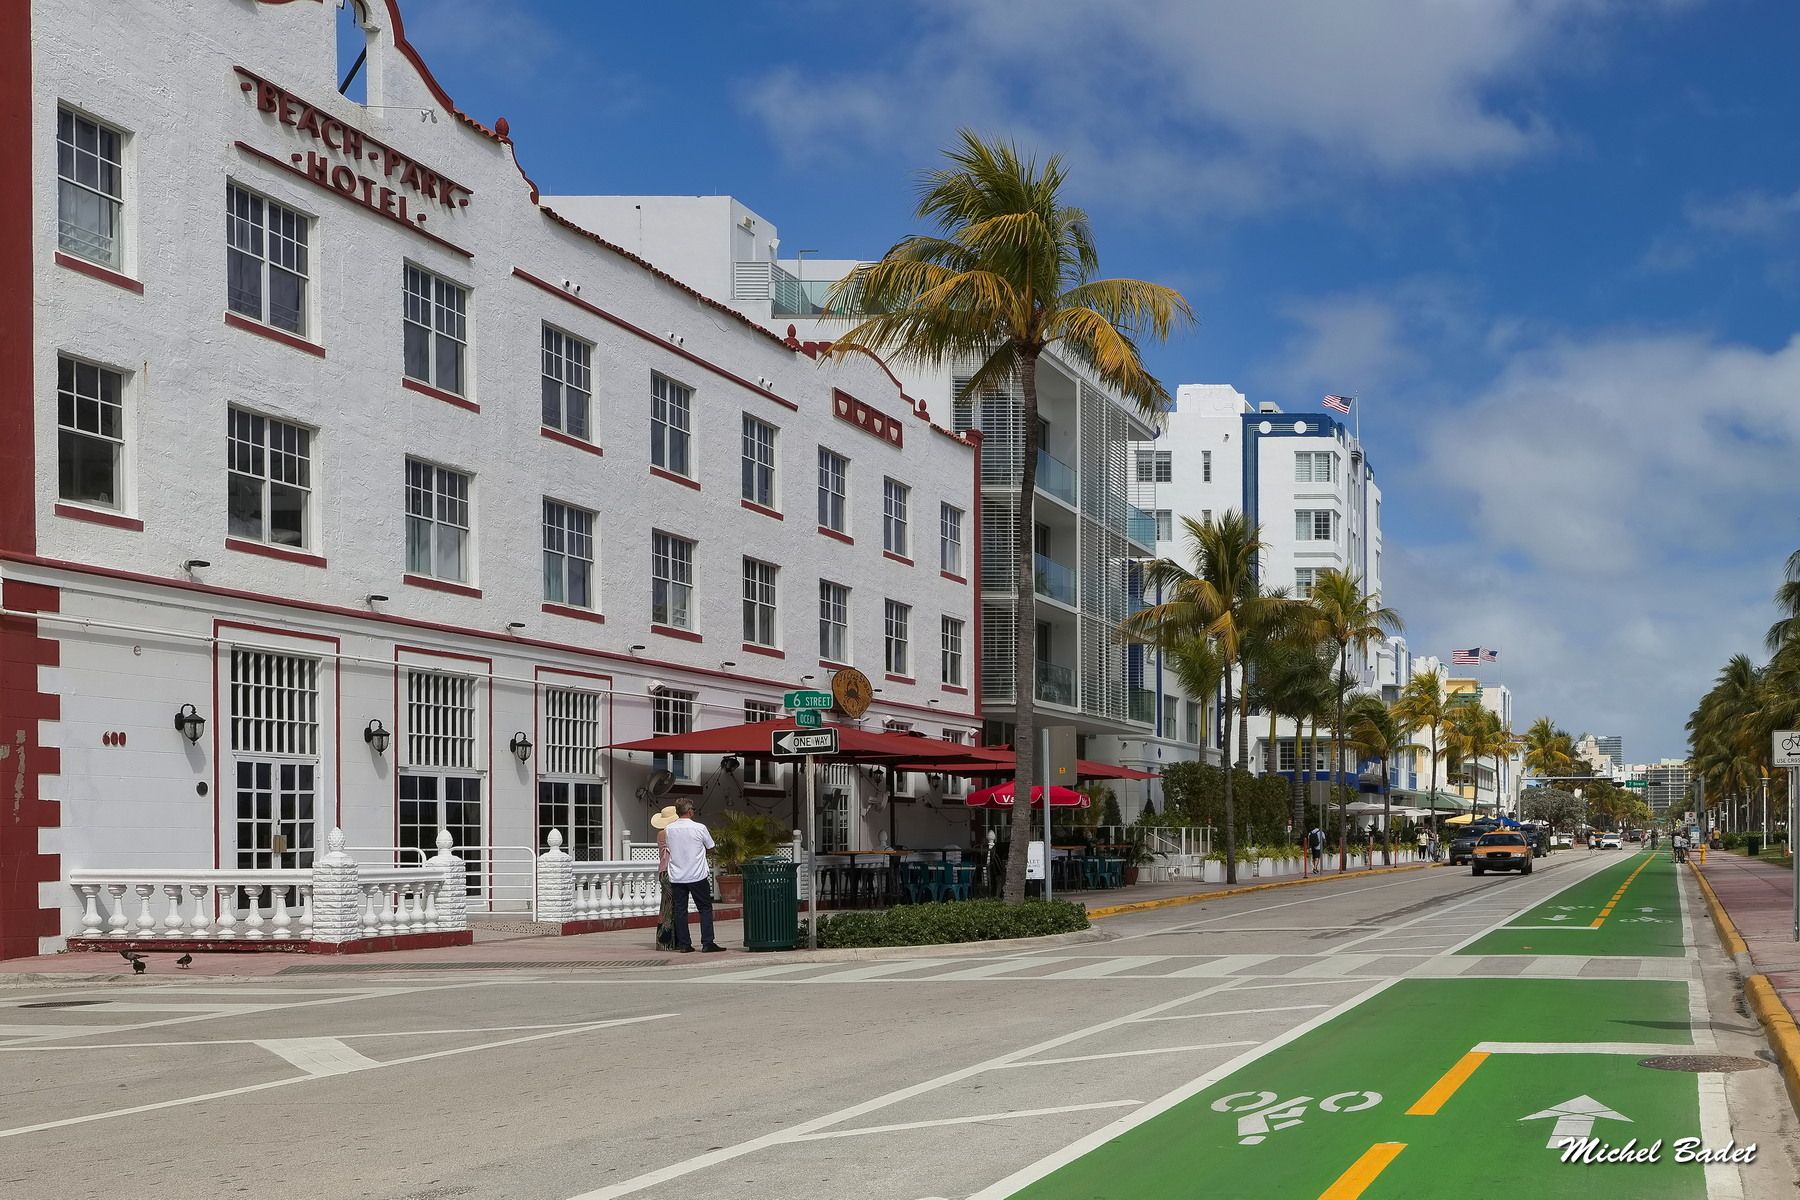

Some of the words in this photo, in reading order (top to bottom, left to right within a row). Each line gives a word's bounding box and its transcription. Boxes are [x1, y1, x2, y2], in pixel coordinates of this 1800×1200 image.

[257, 80, 363, 160] BEACH
[384, 149, 458, 208] PARK
[307, 151, 414, 226] HOTEL
[793, 693, 801, 707] 6
[805, 696, 831, 707] STREET
[102, 730, 127, 746] 600
[793, 737, 812, 747] ONE
[814, 735, 829, 746] WAY
